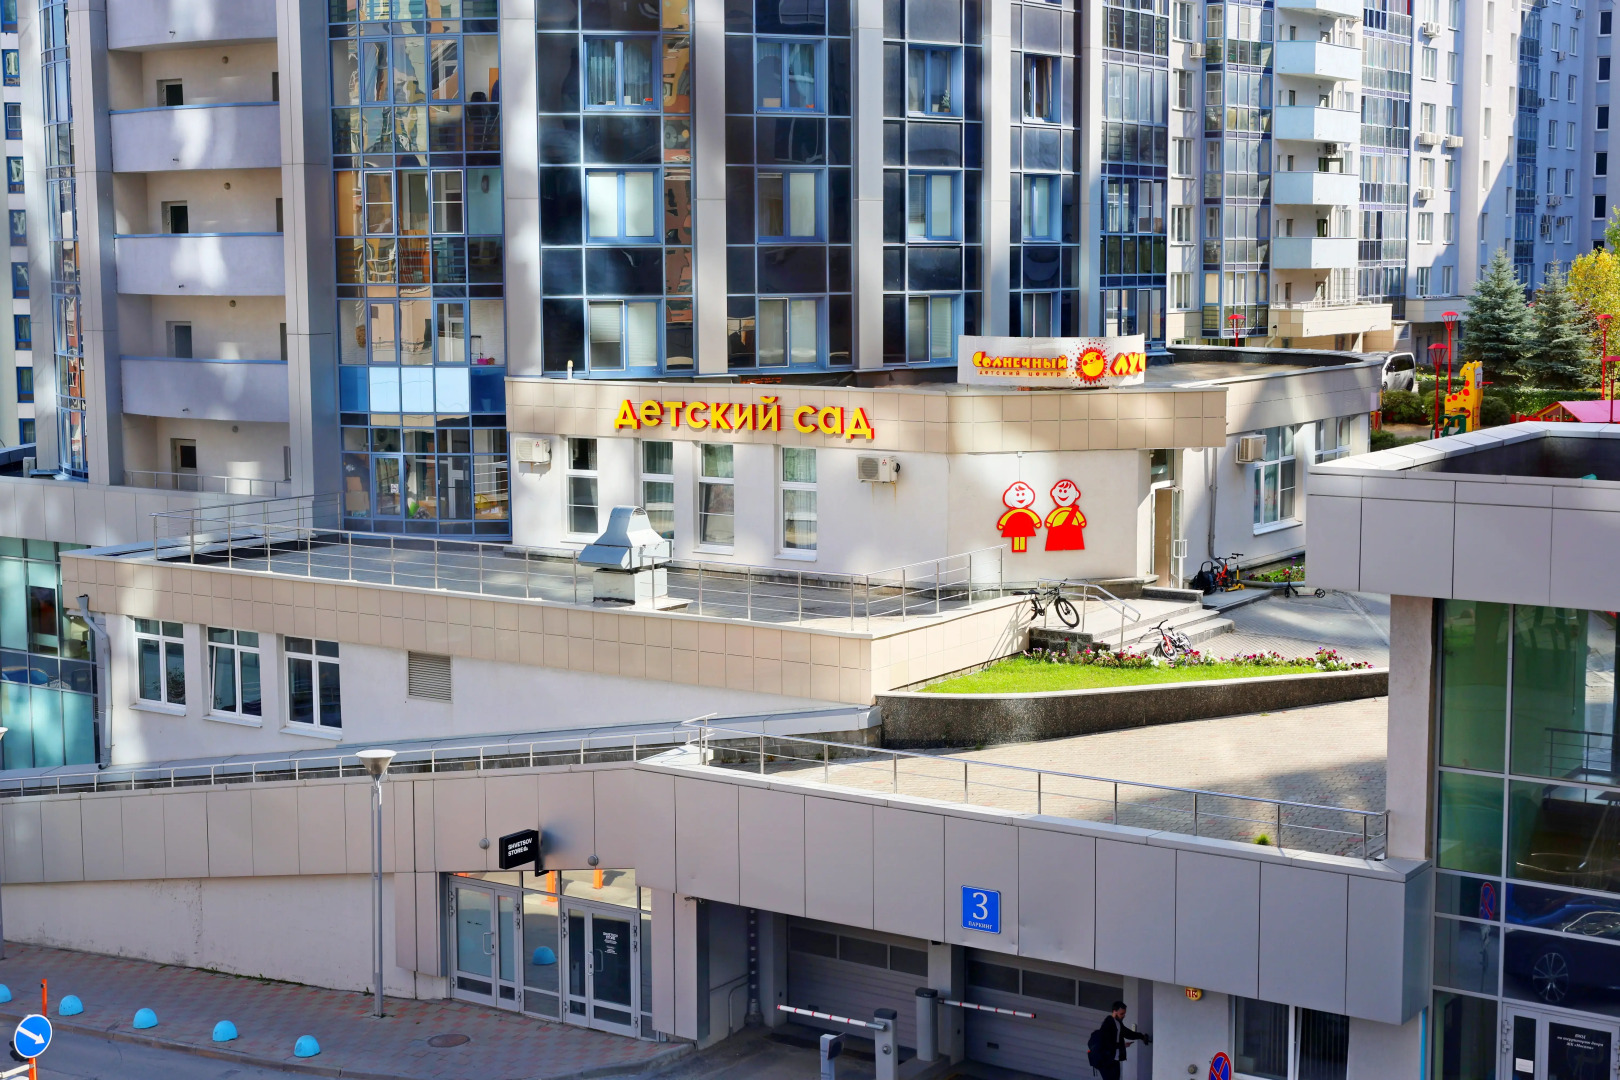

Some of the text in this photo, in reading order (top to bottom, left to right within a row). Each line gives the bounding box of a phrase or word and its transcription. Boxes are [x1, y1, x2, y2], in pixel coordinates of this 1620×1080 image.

[793, 405, 875, 439] сад
[972, 892, 989, 920] 3
[968, 920, 993, 930] ПАРКИНГ
